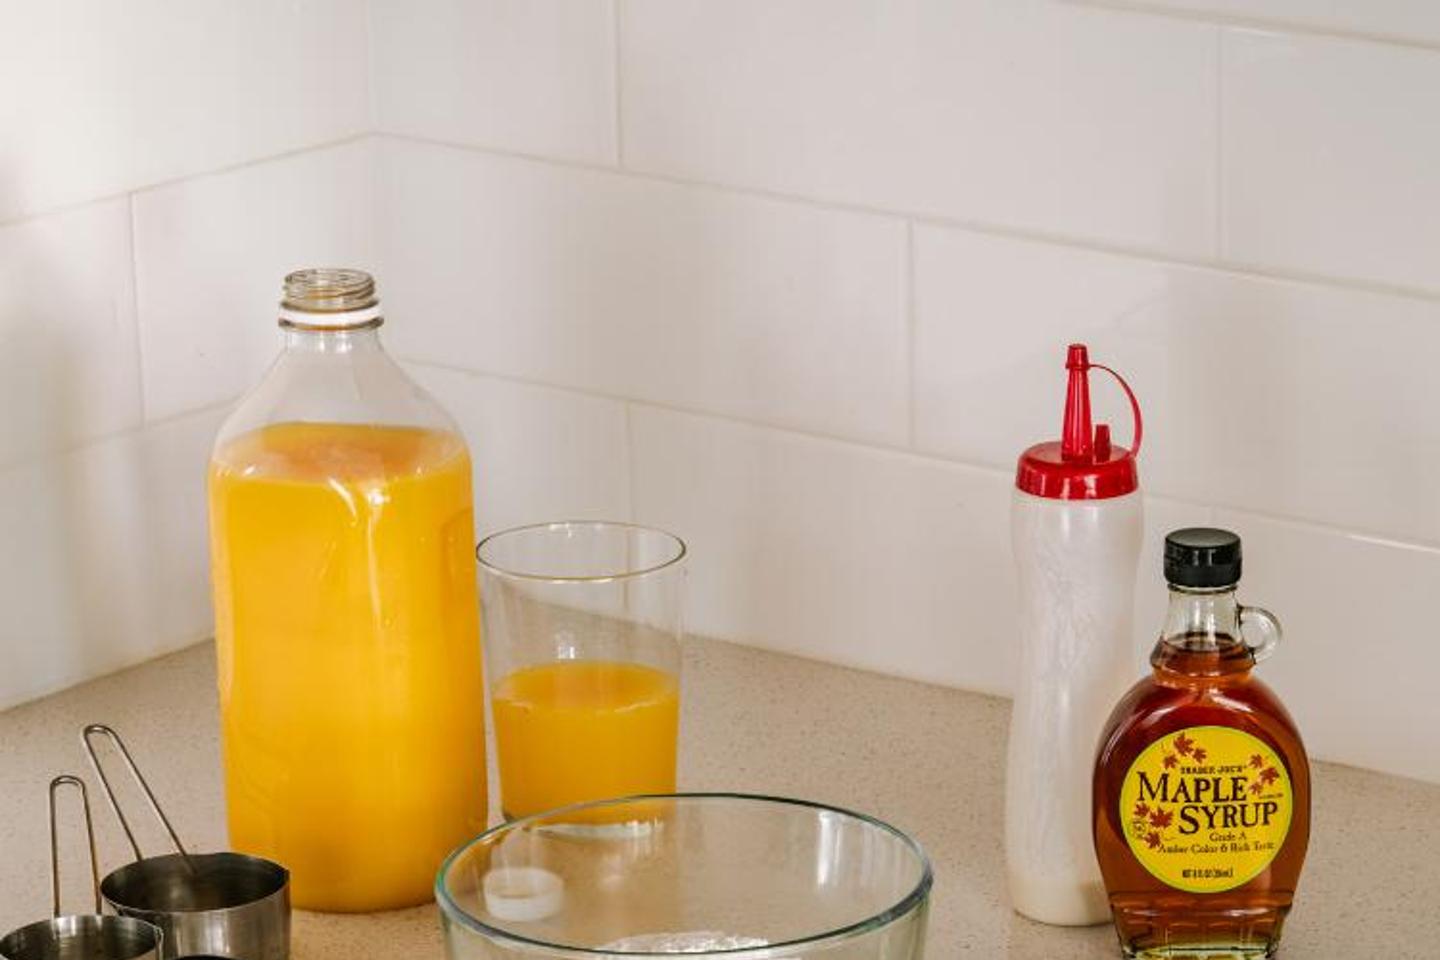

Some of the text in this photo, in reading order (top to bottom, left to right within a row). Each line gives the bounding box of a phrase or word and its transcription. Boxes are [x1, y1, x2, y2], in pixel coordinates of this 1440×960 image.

[1136, 771, 1248, 803] MAPLE
[1178, 801, 1278, 835] SYRUP
[1209, 831, 1247, 841] Grade A
[1158, 844, 1188, 853] Amber
[1191, 844, 1218, 853] Color
